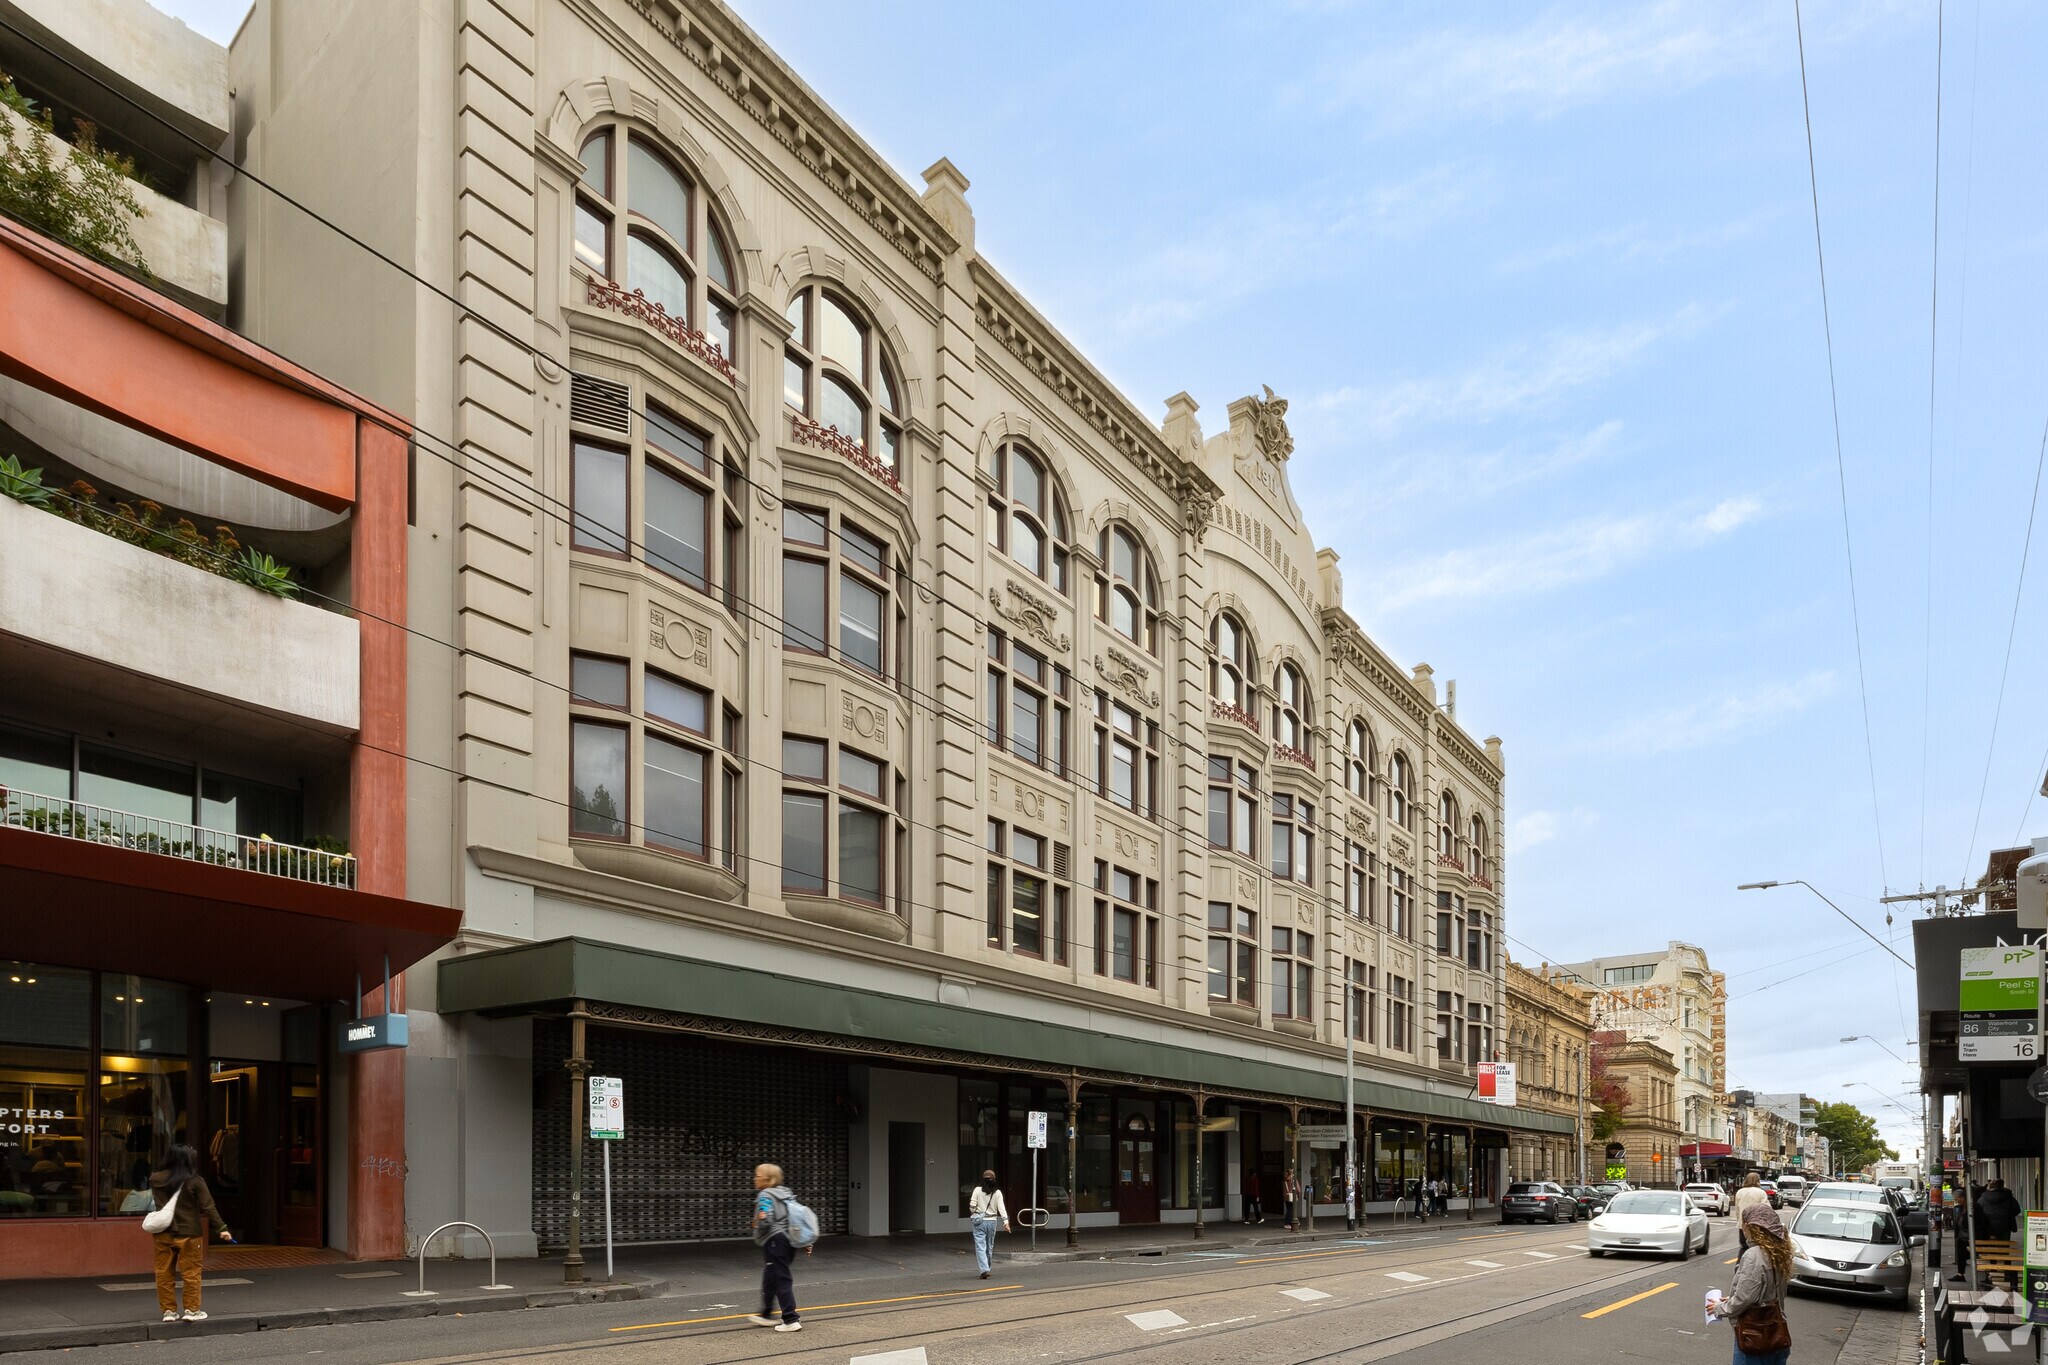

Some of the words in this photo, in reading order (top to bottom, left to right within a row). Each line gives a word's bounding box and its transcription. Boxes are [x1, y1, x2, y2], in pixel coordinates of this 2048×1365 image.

[1999, 981, 2021, 989] Peel
[2023, 980, 2035, 988] St
[348, 1025, 376, 1042] HOMMEY.
[1963, 1024, 1979, 1033] 86
[1712, 975, 1725, 1093] PATERSONS
[2013, 1043, 2034, 1057] 16
[592, 1078, 604, 1086] 6P
[592, 1096, 604, 1104] 2P
[0, 1108, 64, 1119] PTERS
